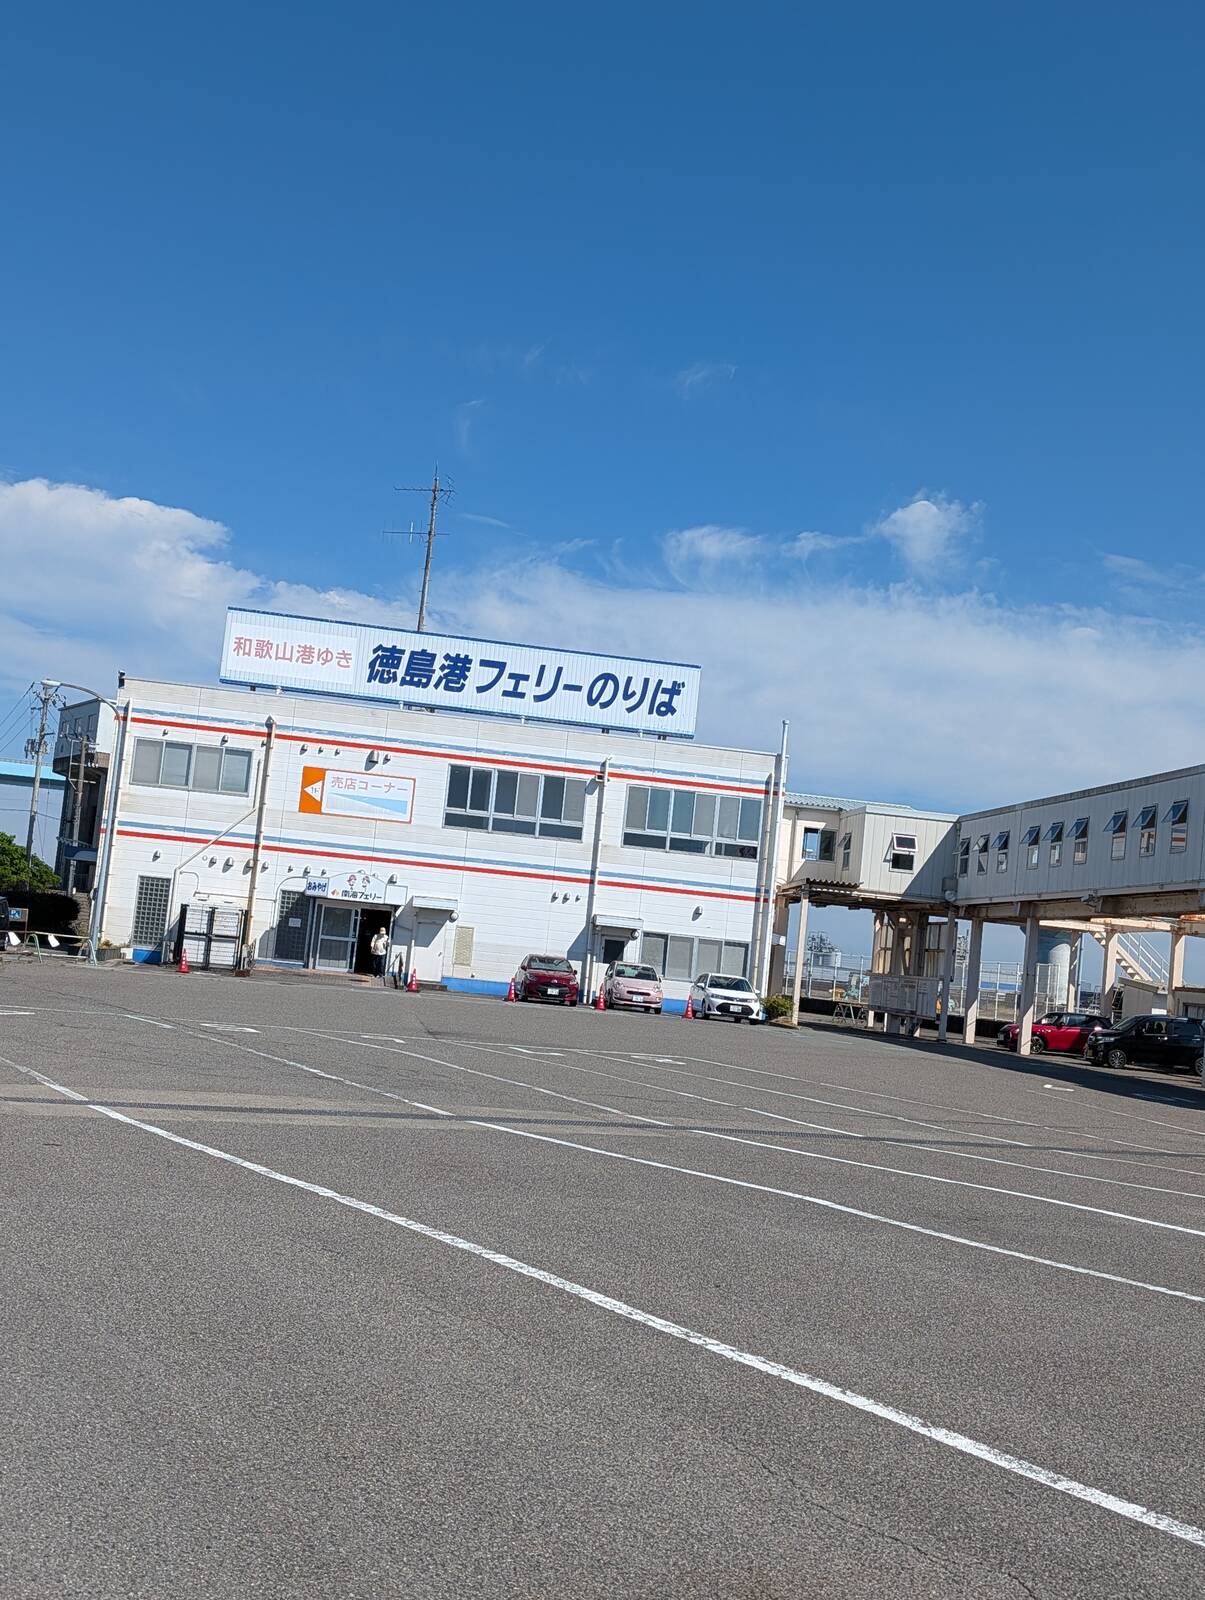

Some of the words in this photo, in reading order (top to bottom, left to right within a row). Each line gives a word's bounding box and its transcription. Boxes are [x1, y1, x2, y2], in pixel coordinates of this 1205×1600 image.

[232, 636, 353, 669] 和歌山港ゆき
[366, 643, 685, 717] 徳島港フェリーのりば
[331, 776, 408, 794] 売店コーナー
[307, 881, 327, 892] おみやげ
